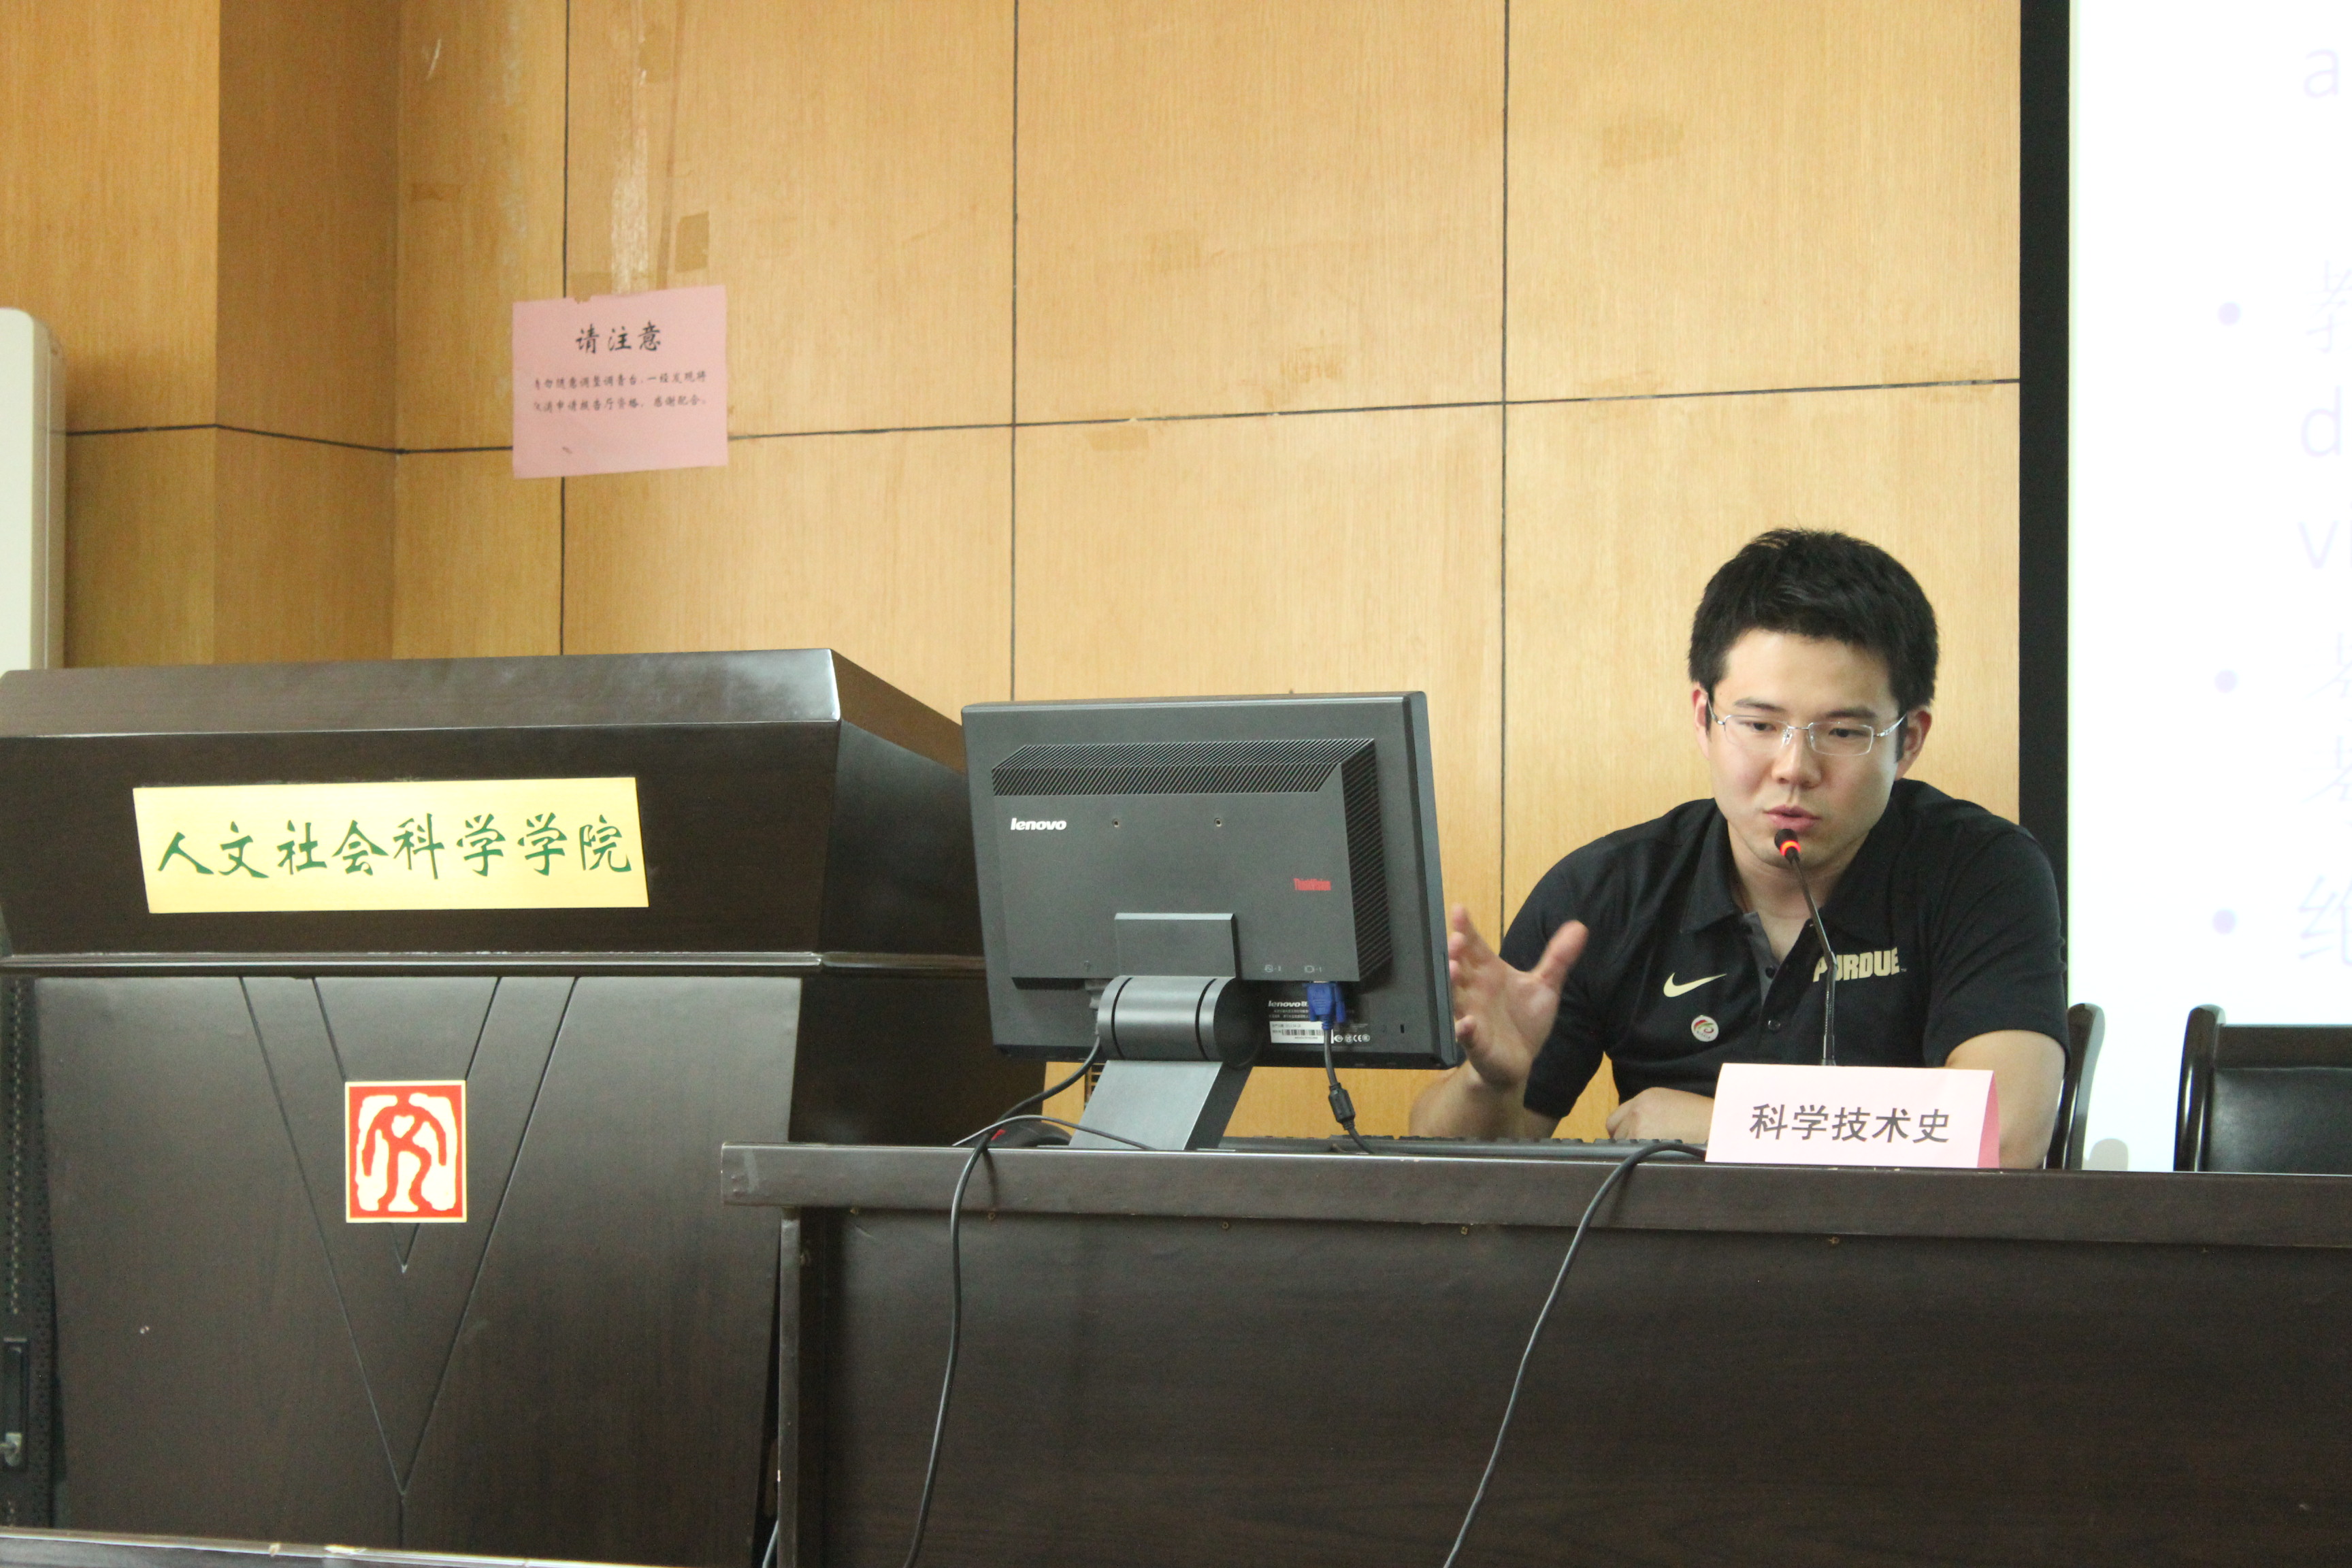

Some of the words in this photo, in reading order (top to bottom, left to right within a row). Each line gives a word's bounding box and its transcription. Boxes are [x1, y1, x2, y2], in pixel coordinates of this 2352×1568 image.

[576, 321, 661, 354] 请注意
[1011, 817, 1067, 831] lenovo
[157, 813, 632, 880] 人文社会科学学院
[1749, 1103, 1950, 1144] 科学技术史
